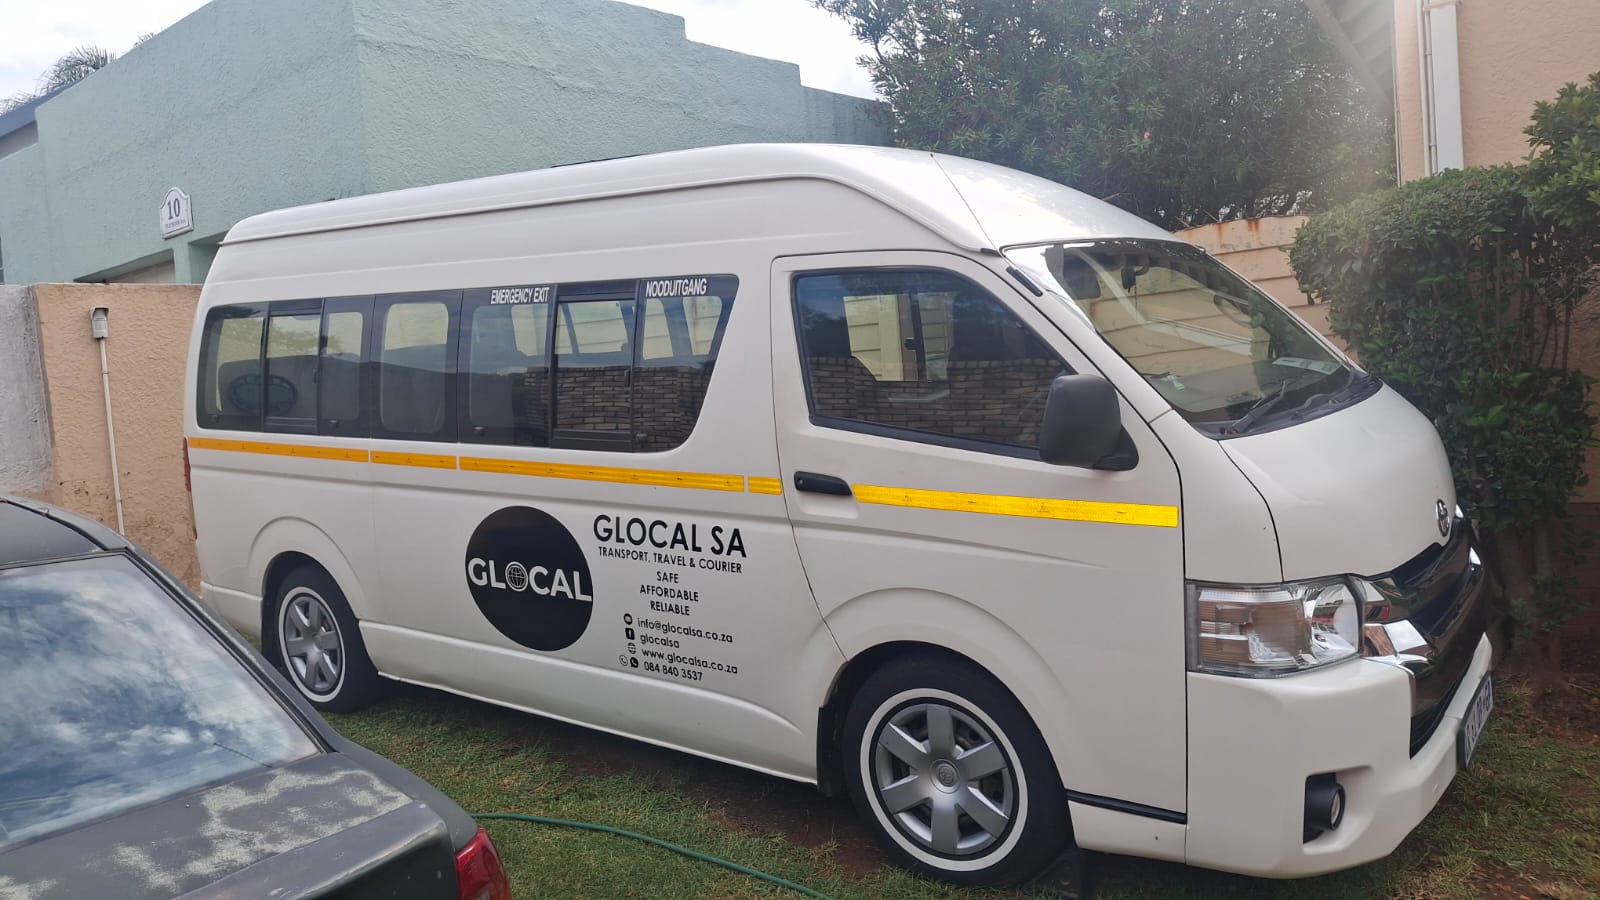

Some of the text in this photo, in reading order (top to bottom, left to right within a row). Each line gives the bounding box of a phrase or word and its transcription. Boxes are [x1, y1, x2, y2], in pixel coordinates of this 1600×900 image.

[167, 198, 180, 220] 10
[490, 286, 550, 305] EMERGENCY EXIT
[645, 277, 707, 297] NOODUITGANG
[593, 514, 747, 558] GLOCAL SA
[653, 552, 687, 567] TRAVEL
[689, 557, 696, 568] &
[699, 558, 742, 574] COURIER
[467, 557, 593, 602] GLOCAL
[656, 570, 679, 584] SAFE
[639, 584, 699, 602] AFFORDABLE
[650, 600, 691, 616] RELIABLE
[637, 617, 733, 643] info@glocalsa.co.za
[640, 633, 680, 649] glocalsa
[641, 648, 738, 675] www.glocalsa.co.za
[643, 661, 703, 681] 084 840 3537
